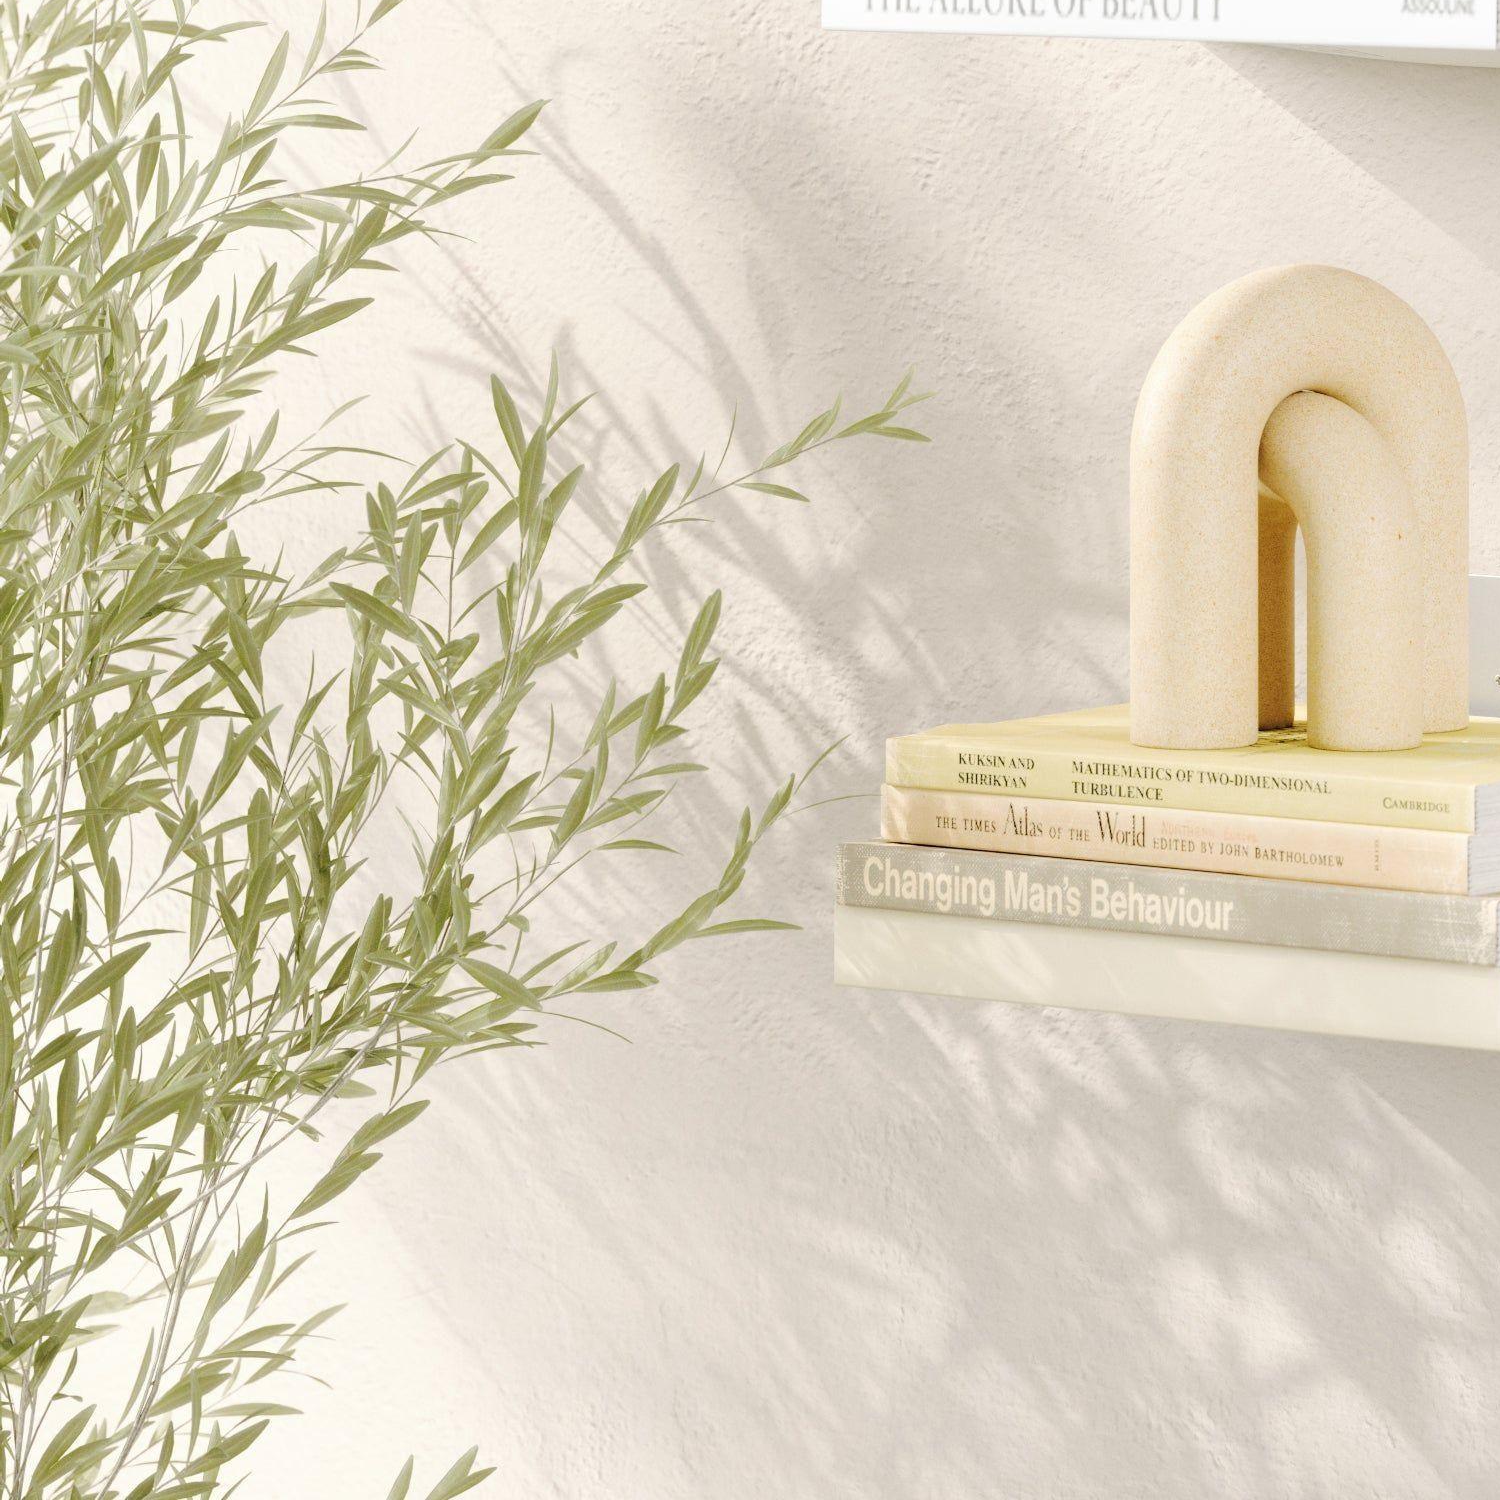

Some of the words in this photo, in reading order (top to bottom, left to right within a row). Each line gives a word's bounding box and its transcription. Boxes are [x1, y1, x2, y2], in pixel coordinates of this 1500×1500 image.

[958, 751, 1006, 770] KUKSIN
[1008, 754, 1036, 772] AND
[1071, 758, 1173, 783] MATHEMATICS
[1174, 768, 1195, 784] OF
[1197, 769, 1332, 796] TWO-DIMENSIONAL
[958, 771, 1030, 790] SHIRIKYAN
[1072, 781, 1165, 802] TURBULENCE
[936, 814, 960, 829] THE
[963, 817, 997, 834] TIMES
[1002, 801, 1044, 838] Atlas
[1049, 825, 1064, 840] OF
[1067, 827, 1092, 842] THE
[1096, 809, 1147, 849] World
[1152, 837, 1196, 853] EDITED
[1200, 841, 1215, 854] BY
[1219, 843, 1249, 857] JOHN
[1254, 846, 1345, 868] BARTHOLOMEW
[864, 855, 998, 917] Changing
[1004, 868, 1082, 919] Man's
[1090, 877, 1235, 932] Behaviour
